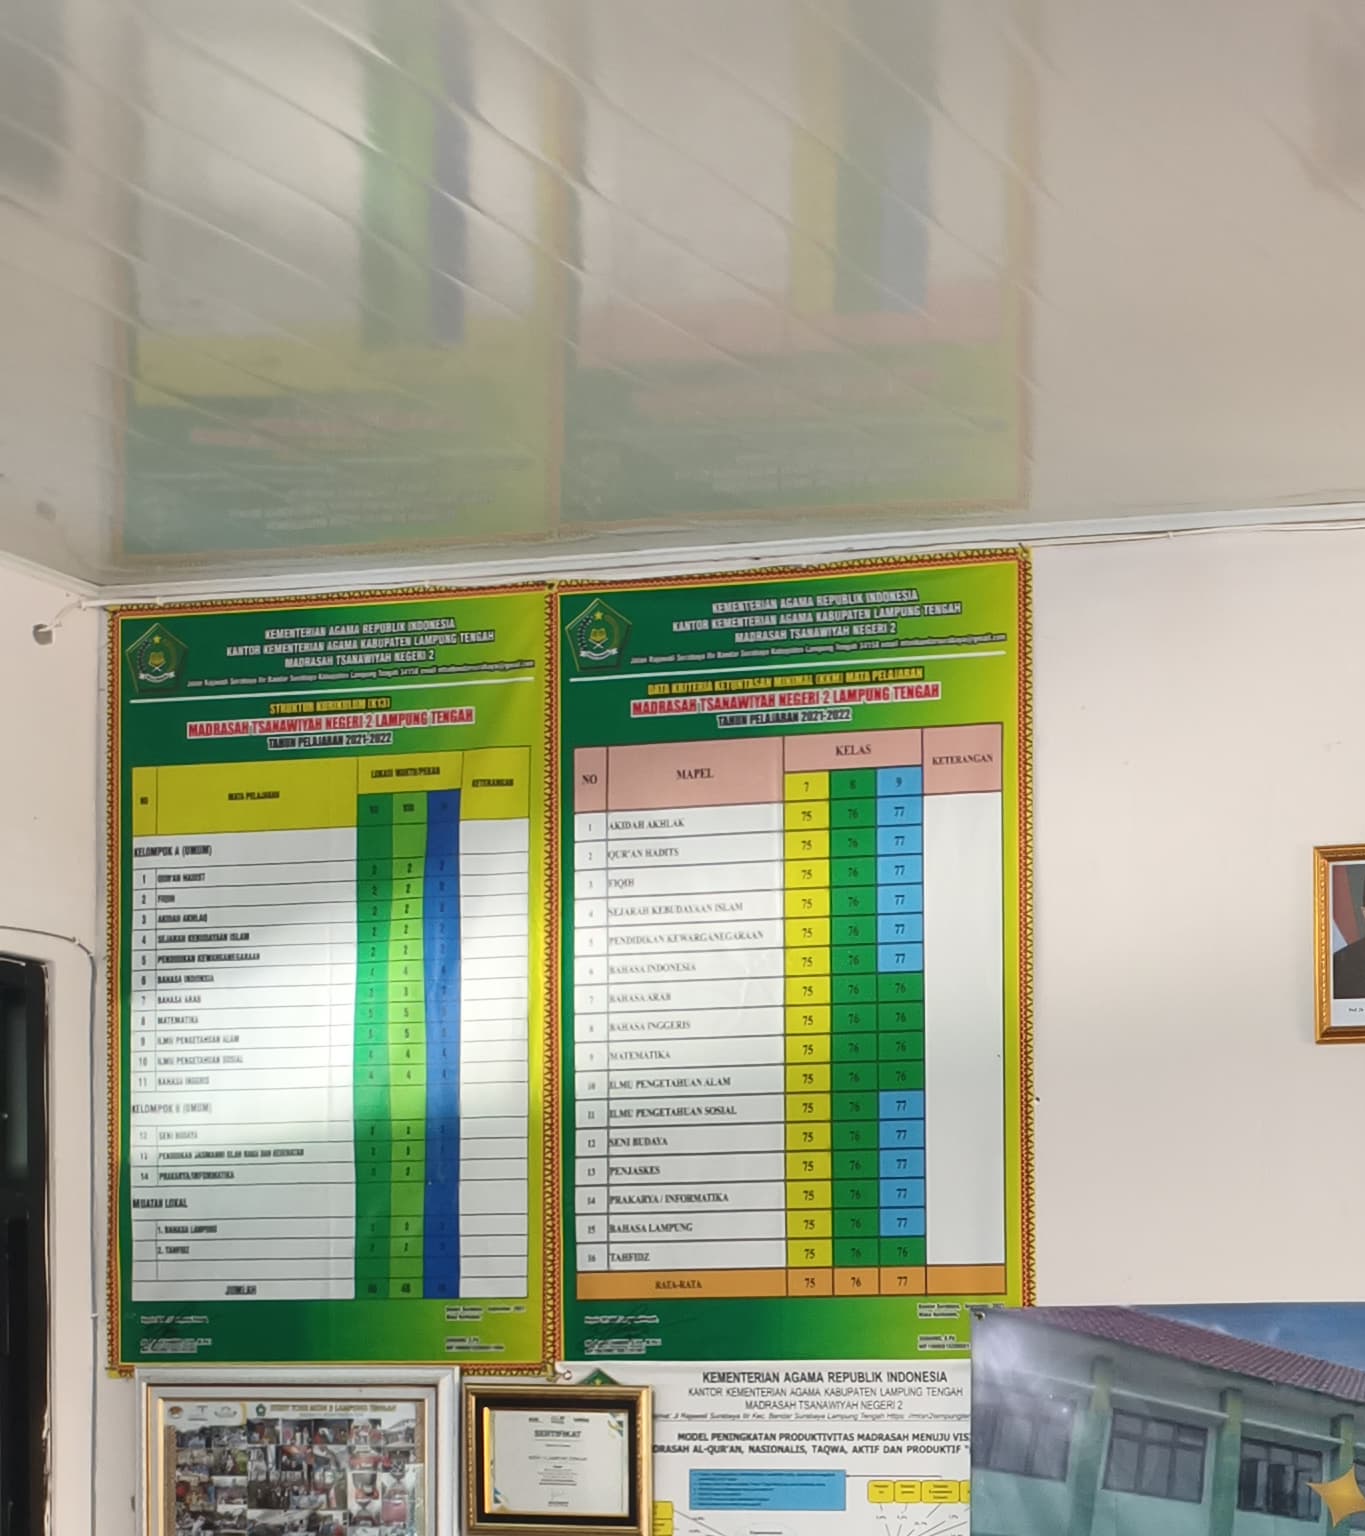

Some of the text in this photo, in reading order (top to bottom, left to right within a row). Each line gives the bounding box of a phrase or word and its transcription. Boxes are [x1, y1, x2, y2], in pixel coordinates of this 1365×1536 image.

[633, 683, 940, 715] MADRASAH TSANAWIYAH NEGERI 2 LAMPUNG TENGAH
[188, 708, 473, 737] MADRASAH TSANAWIYAH NEGERI 2 LAMPUNG TENGAH
[835, 744, 872, 757] KELAS
[933, 753, 992, 766] KETERANGAN
[583, 774, 597, 785] NO
[676, 768, 714, 780] MAPEL
[703, 1371, 947, 1383] KEMENTERIAN AGAMA REPUBLIK INDONESIA
[688, 1387, 963, 1397] KANTOR KEMENTERIAN AGAMA KABUPATEN LAMPUNG TENGAH
[745, 1401, 903, 1409] MADRASAH TSANAWIYAH NEGERI 2
[678, 1433, 708, 1442] MODEL
[712, 1433, 776, 1442] PENINGKATAN
[779, 1433, 854, 1441] PRODUKTIVITAS
[857, 1433, 909, 1442] MADRASAH
[912, 1433, 951, 1442] MENUJU
[749, 1445, 807, 1455] NASIONALIS,
[812, 1445, 848, 1455] TAQWA,
[852, 1445, 879, 1454] AKTIF
[883, 1445, 903, 1454] DAN
[907, 1445, 961, 1454] PRODUKTIF
